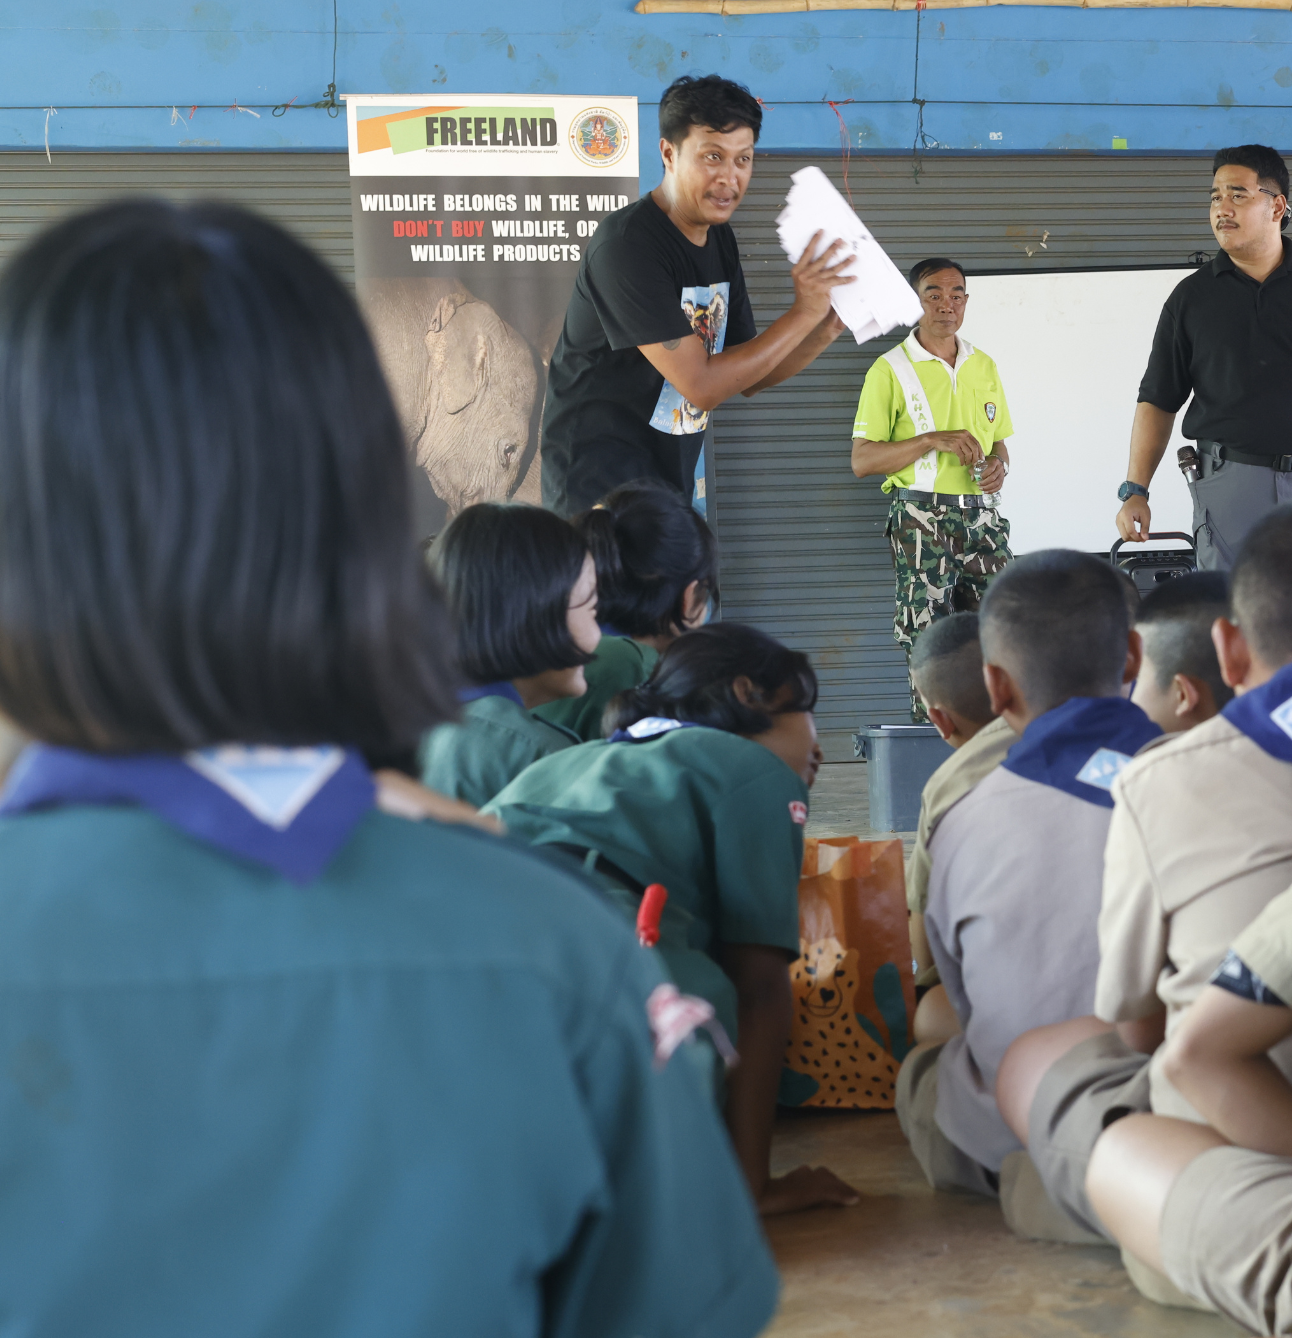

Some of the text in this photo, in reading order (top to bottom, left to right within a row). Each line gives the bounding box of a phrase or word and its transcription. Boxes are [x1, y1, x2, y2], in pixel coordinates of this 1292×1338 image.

[426, 116, 557, 147] FREELAND
[360, 194, 629, 212] WILDLIFE BELONGS IN THE WILD
[393, 220, 599, 239] DON'T BUY WILDLIFE, OR
[411, 245, 581, 262] WILDLIFE PRODUCTS
